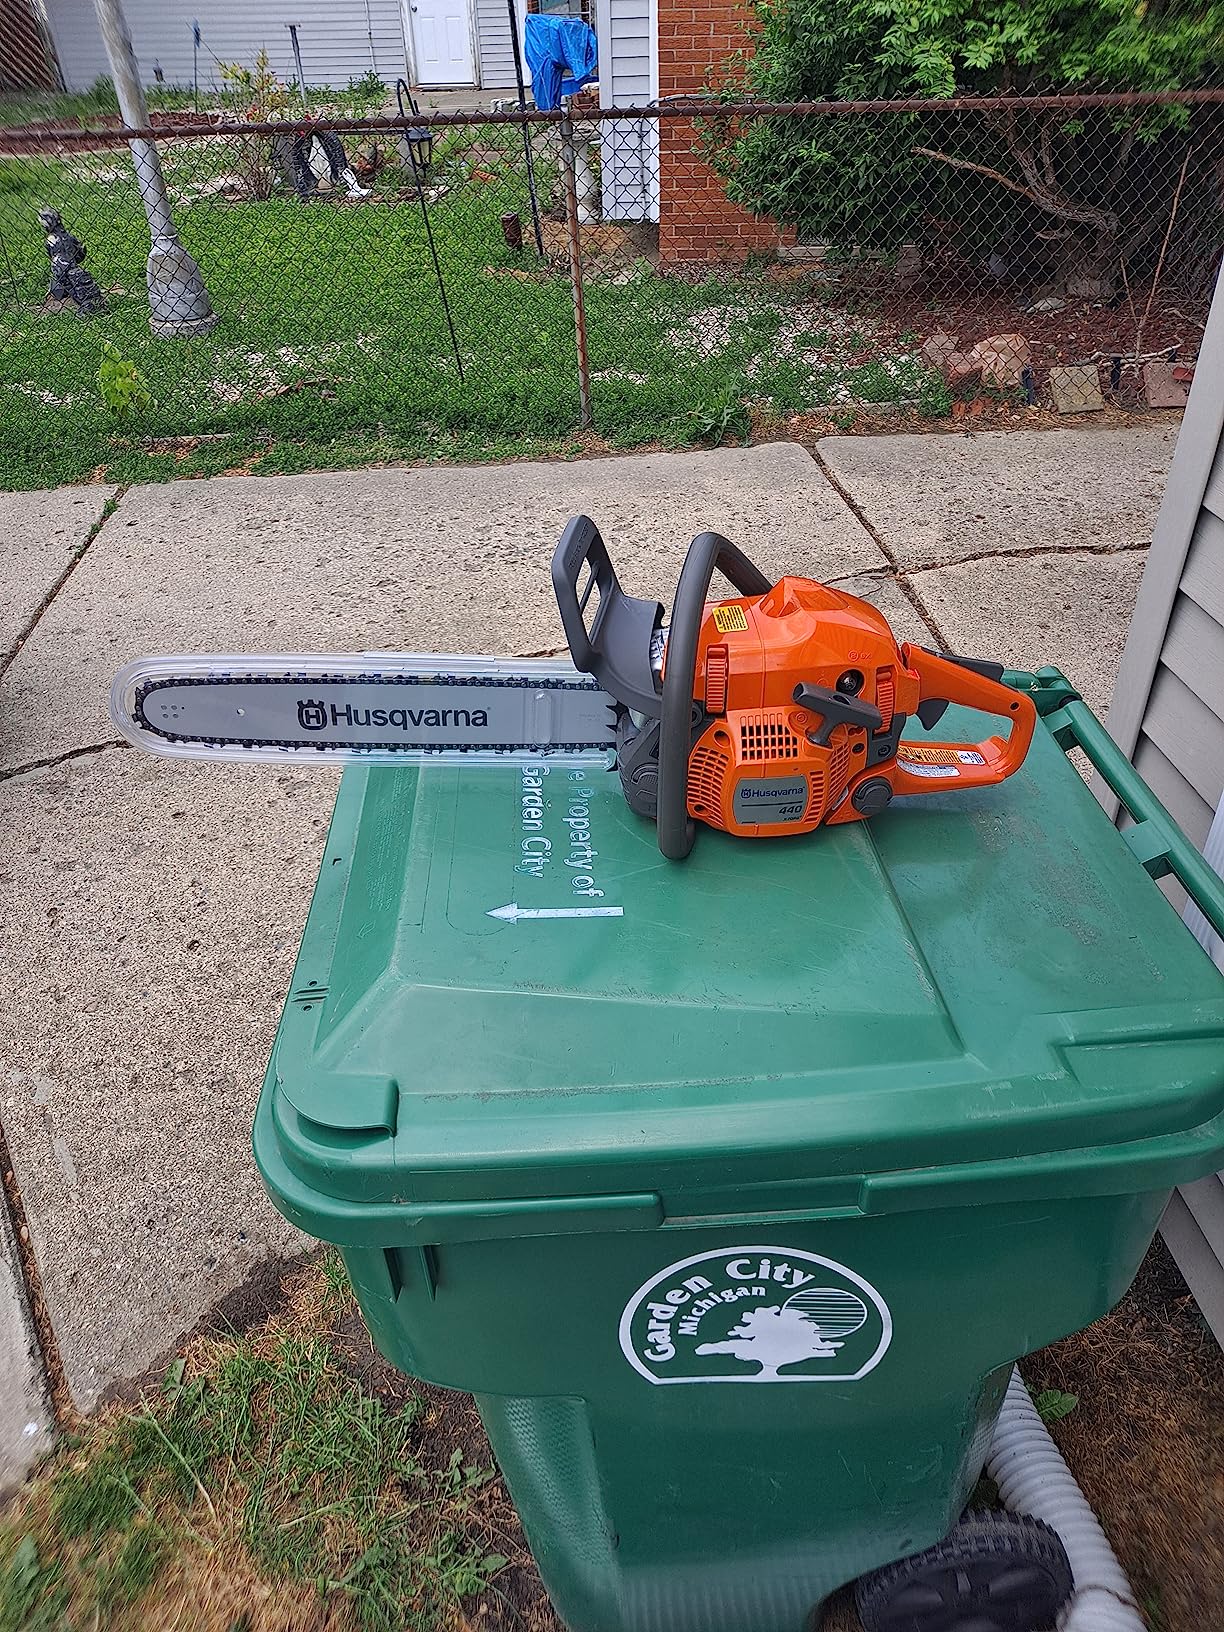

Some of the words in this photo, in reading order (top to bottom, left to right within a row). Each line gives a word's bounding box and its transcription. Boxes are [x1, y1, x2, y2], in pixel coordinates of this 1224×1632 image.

[330, 703, 489, 730] Husqvarna
[521, 765, 551, 832] Garden
[752, 787, 803, 797] Husqvarna
[779, 805, 802, 814] 440
[562, 786, 599, 870] Property
[514, 836, 552, 878] City
[571, 875, 605, 897] of
[643, 1274, 714, 1363] Garden
[725, 1258, 816, 1289] City
[677, 1284, 767, 1337] Michigan
